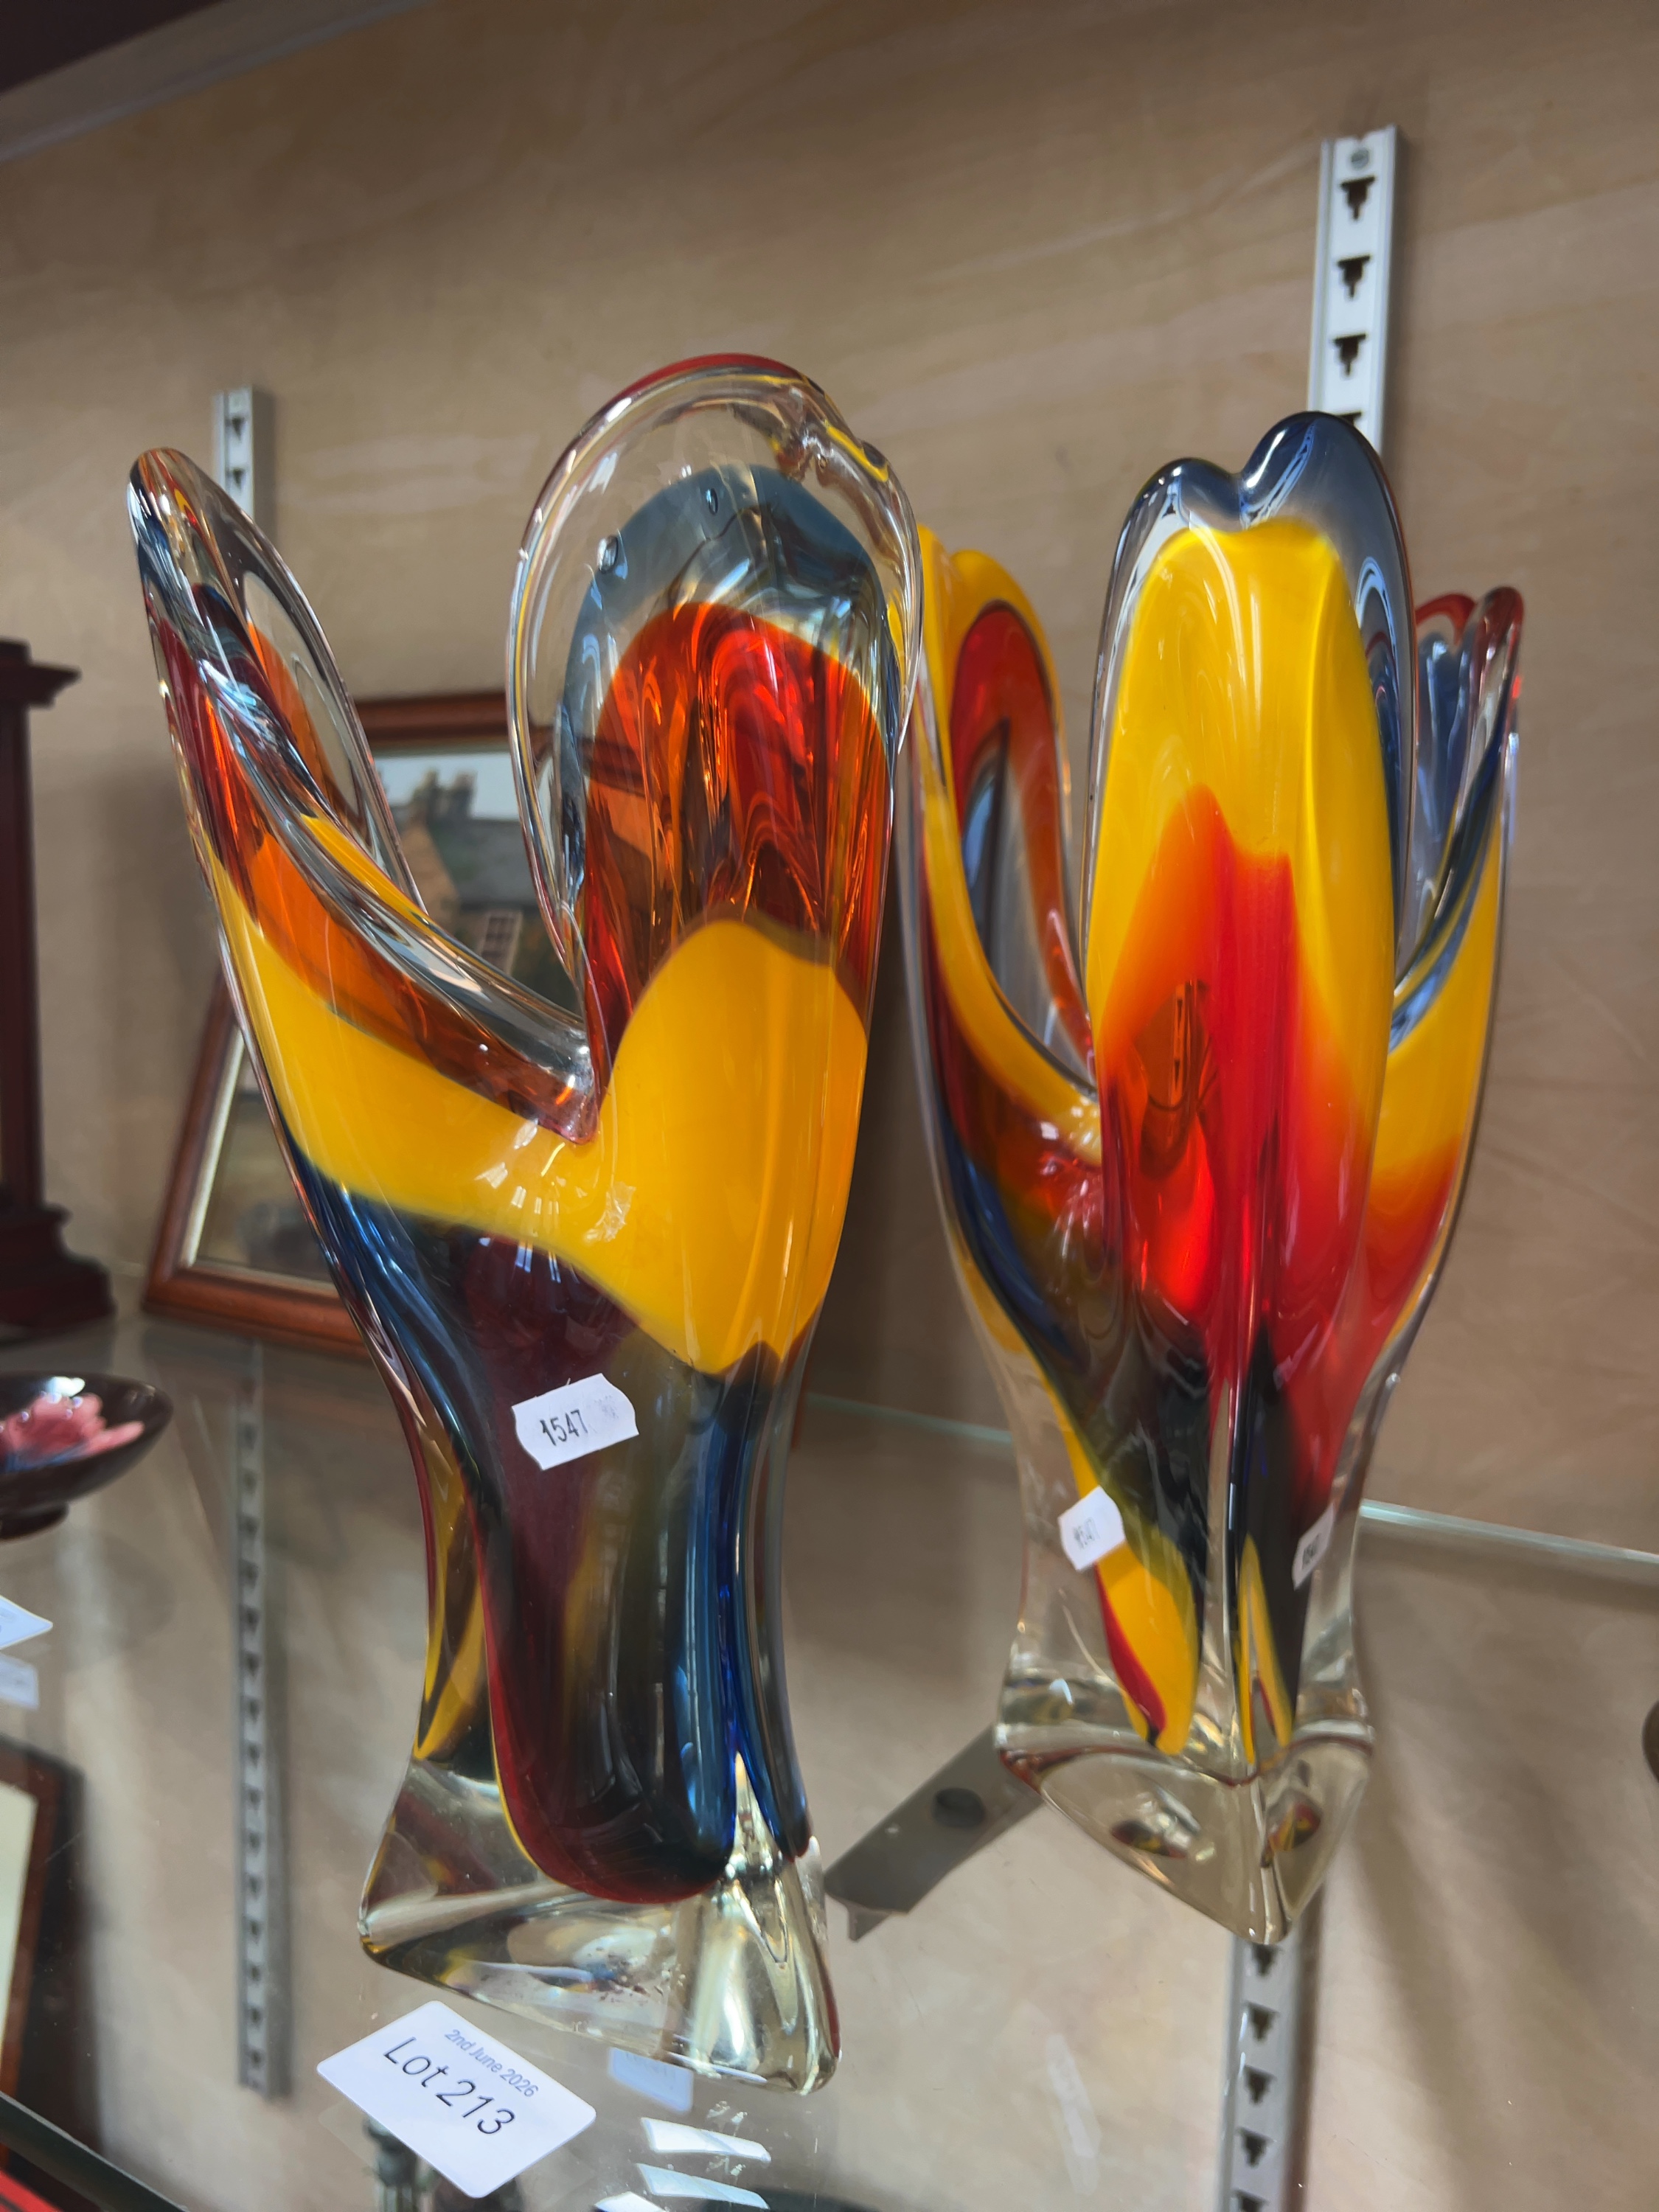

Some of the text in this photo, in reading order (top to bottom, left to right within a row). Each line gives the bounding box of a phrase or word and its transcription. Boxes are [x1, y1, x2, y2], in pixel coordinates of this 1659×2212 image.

[539, 1408, 588, 1447] 1547
[383, 2037, 515, 2135] Lot 213
[445, 2028, 539, 2098] 2nd June 2026
